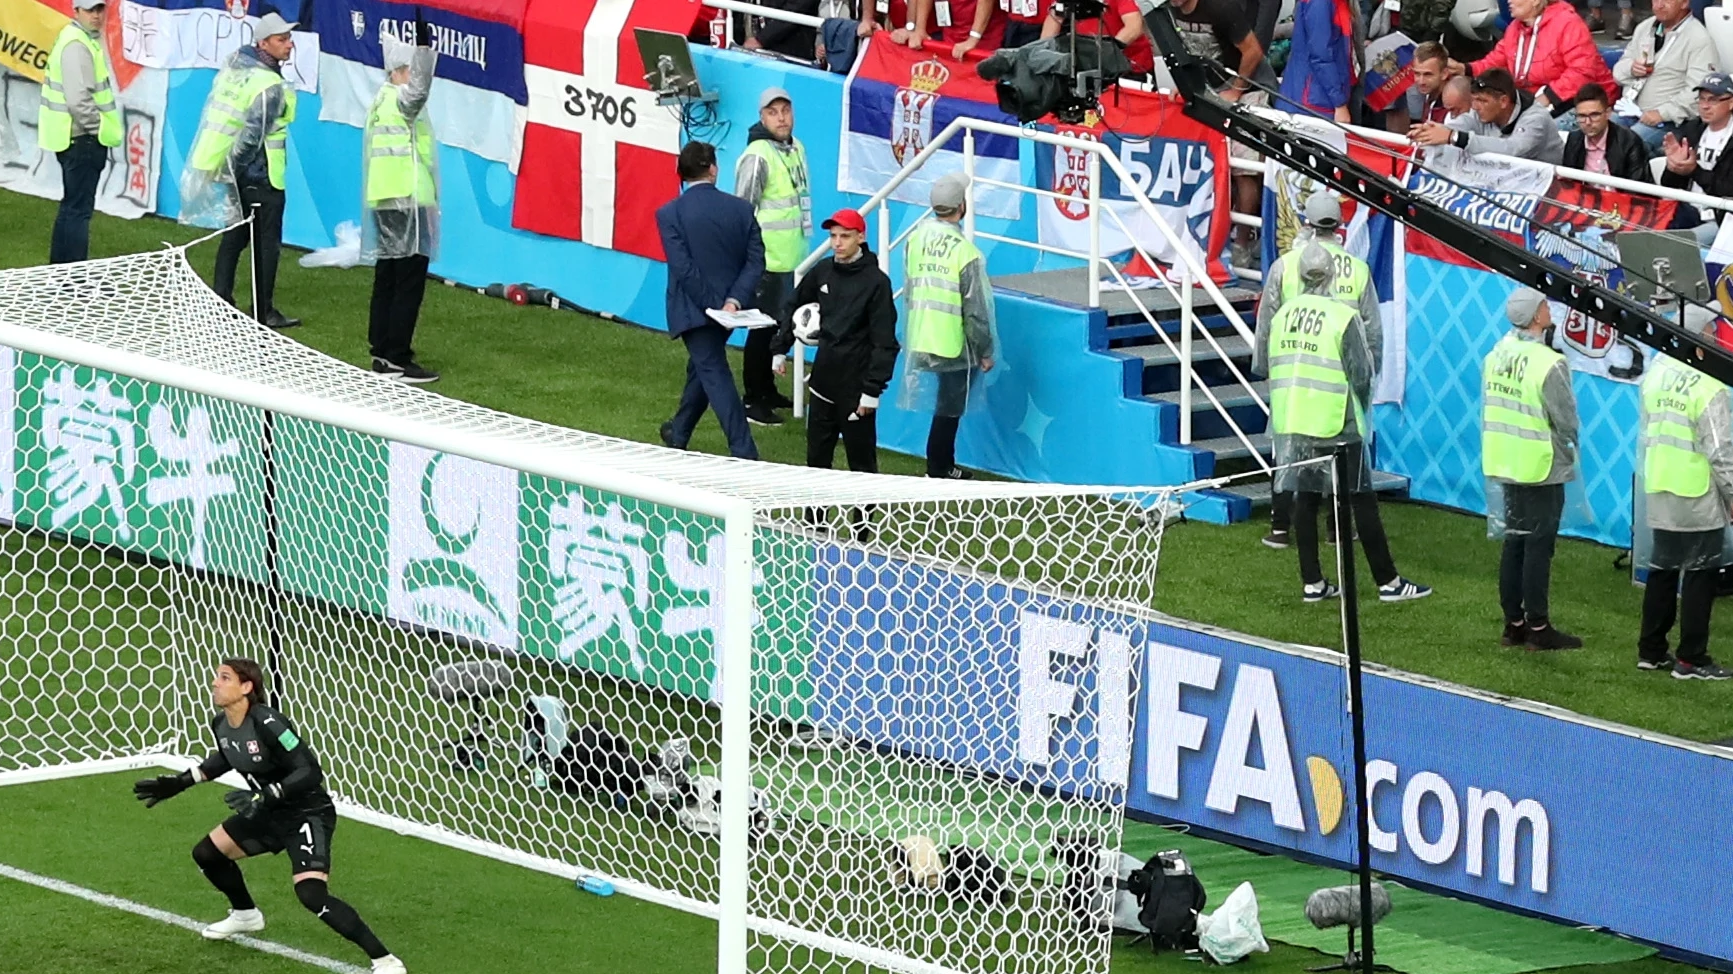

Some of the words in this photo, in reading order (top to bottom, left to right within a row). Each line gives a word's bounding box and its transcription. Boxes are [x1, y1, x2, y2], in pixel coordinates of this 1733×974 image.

[379, 18, 487, 71] АЛЕСИНАЦ
[564, 84, 637, 129] 3706
[41, 366, 240, 570] 蒙牛
[298, 822, 313, 845] 1
